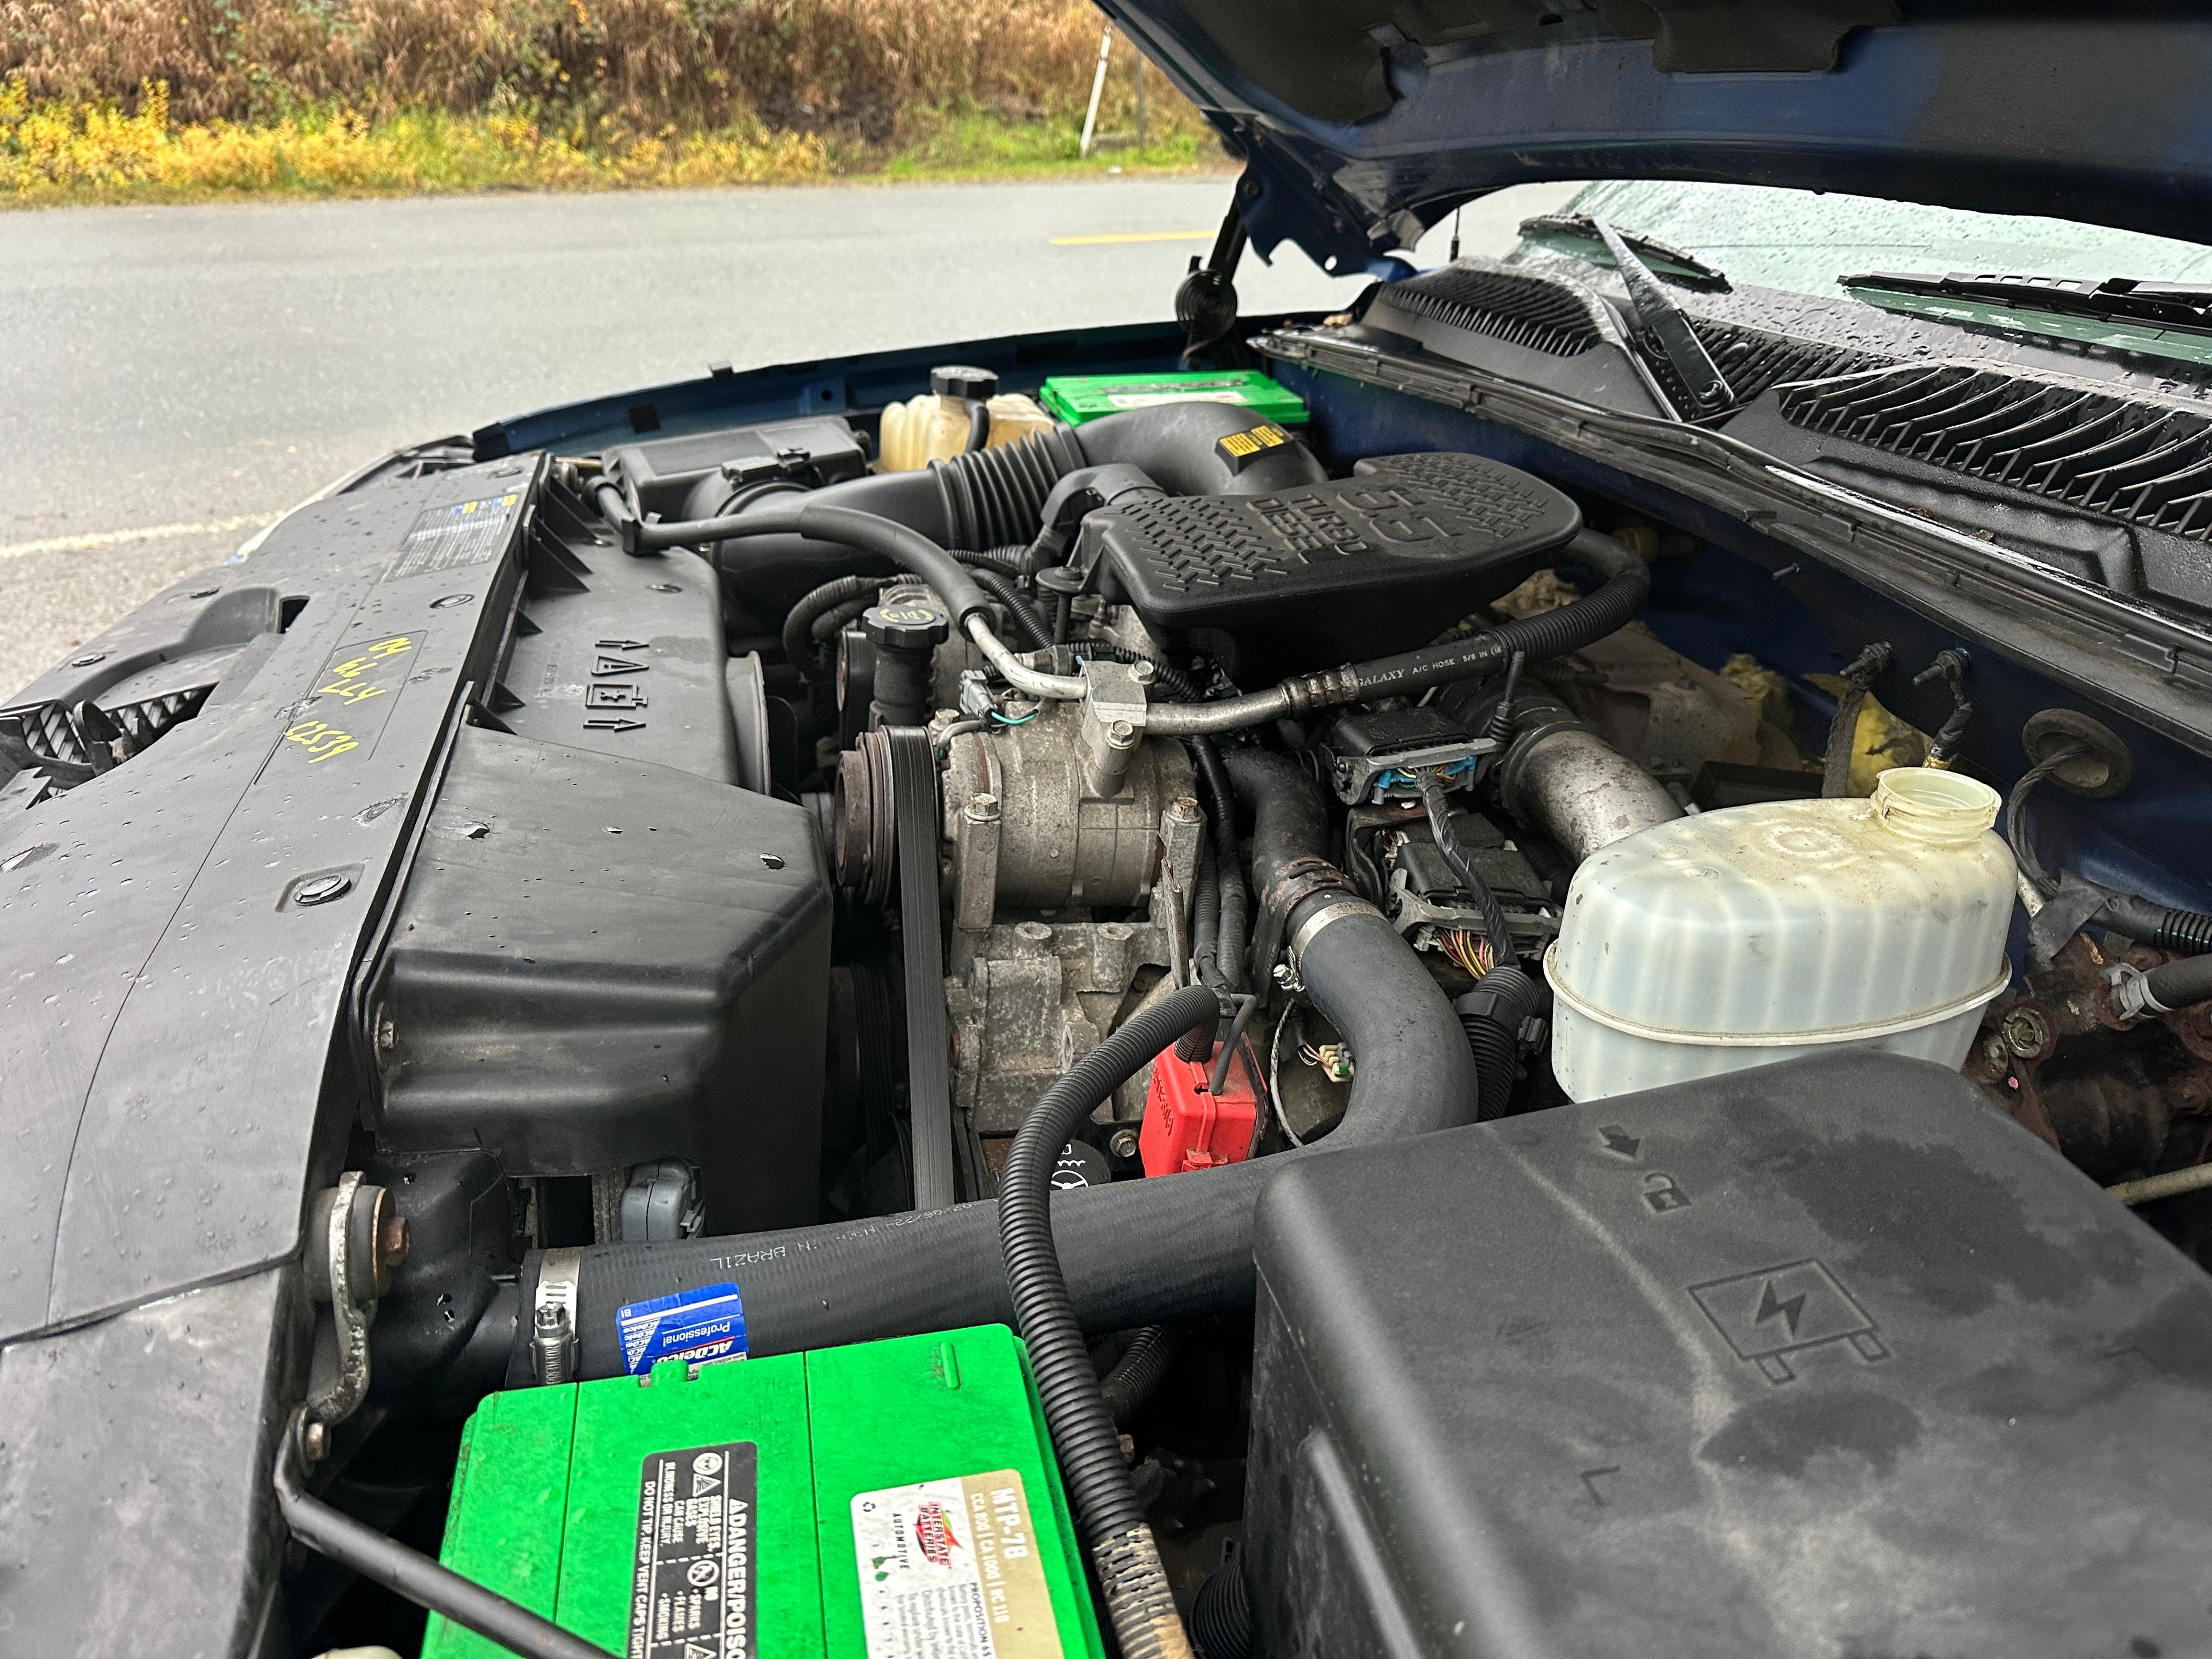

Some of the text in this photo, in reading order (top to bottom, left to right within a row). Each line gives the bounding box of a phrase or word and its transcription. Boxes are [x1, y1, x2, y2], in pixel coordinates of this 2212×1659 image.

[1246, 497, 1334, 563] DIESEL
[1288, 494, 1368, 555] TURBO
[1412, 665, 1428, 674] A/C
[1432, 658, 1455, 669] HOSE
[1463, 653, 1476, 662] 5/8
[1479, 650, 1488, 658] IN
[710, 1246, 786, 1268] BRAZIL
[623, 1320, 660, 1334] ACDelco
[663, 1321, 730, 1347] Professional
[657, 1340, 733, 1363] ACDelco
[643, 1481, 656, 1497] DO
[663, 1461, 676, 1503] BLINDNESS
[642, 1497, 655, 1517] NOT
[662, 1502, 673, 1514] OR
[685, 1498, 698, 1527] GASES
[710, 1495, 722, 1525] SHIELD
[970, 1493, 986, 1510] CCA
[672, 1500, 685, 1544] CAN CAUSE
[695, 1497, 709, 1544] EXPLOSIVE
[920, 1508, 938, 1562] BATTERIES
[930, 1503, 949, 1563] INTERSTATE
[991, 1487, 1028, 1560] MTP-78
[638, 1536, 652, 1564] KEEP
[892, 1513, 910, 1569] AUTOMOTIVE
[979, 1540, 995, 1553] CA
[635, 1565, 650, 1593] VENT
[982, 1555, 1000, 1579] 1000
[704, 1586, 718, 1601] NO
[633, 1594, 647, 1626] CAPS
[656, 1598, 670, 1640] SMOKING
[672, 1596, 686, 1633] FLAMES
[687, 1593, 702, 1629] SPARKS
[970, 1582, 989, 1642] PROPOSITION
